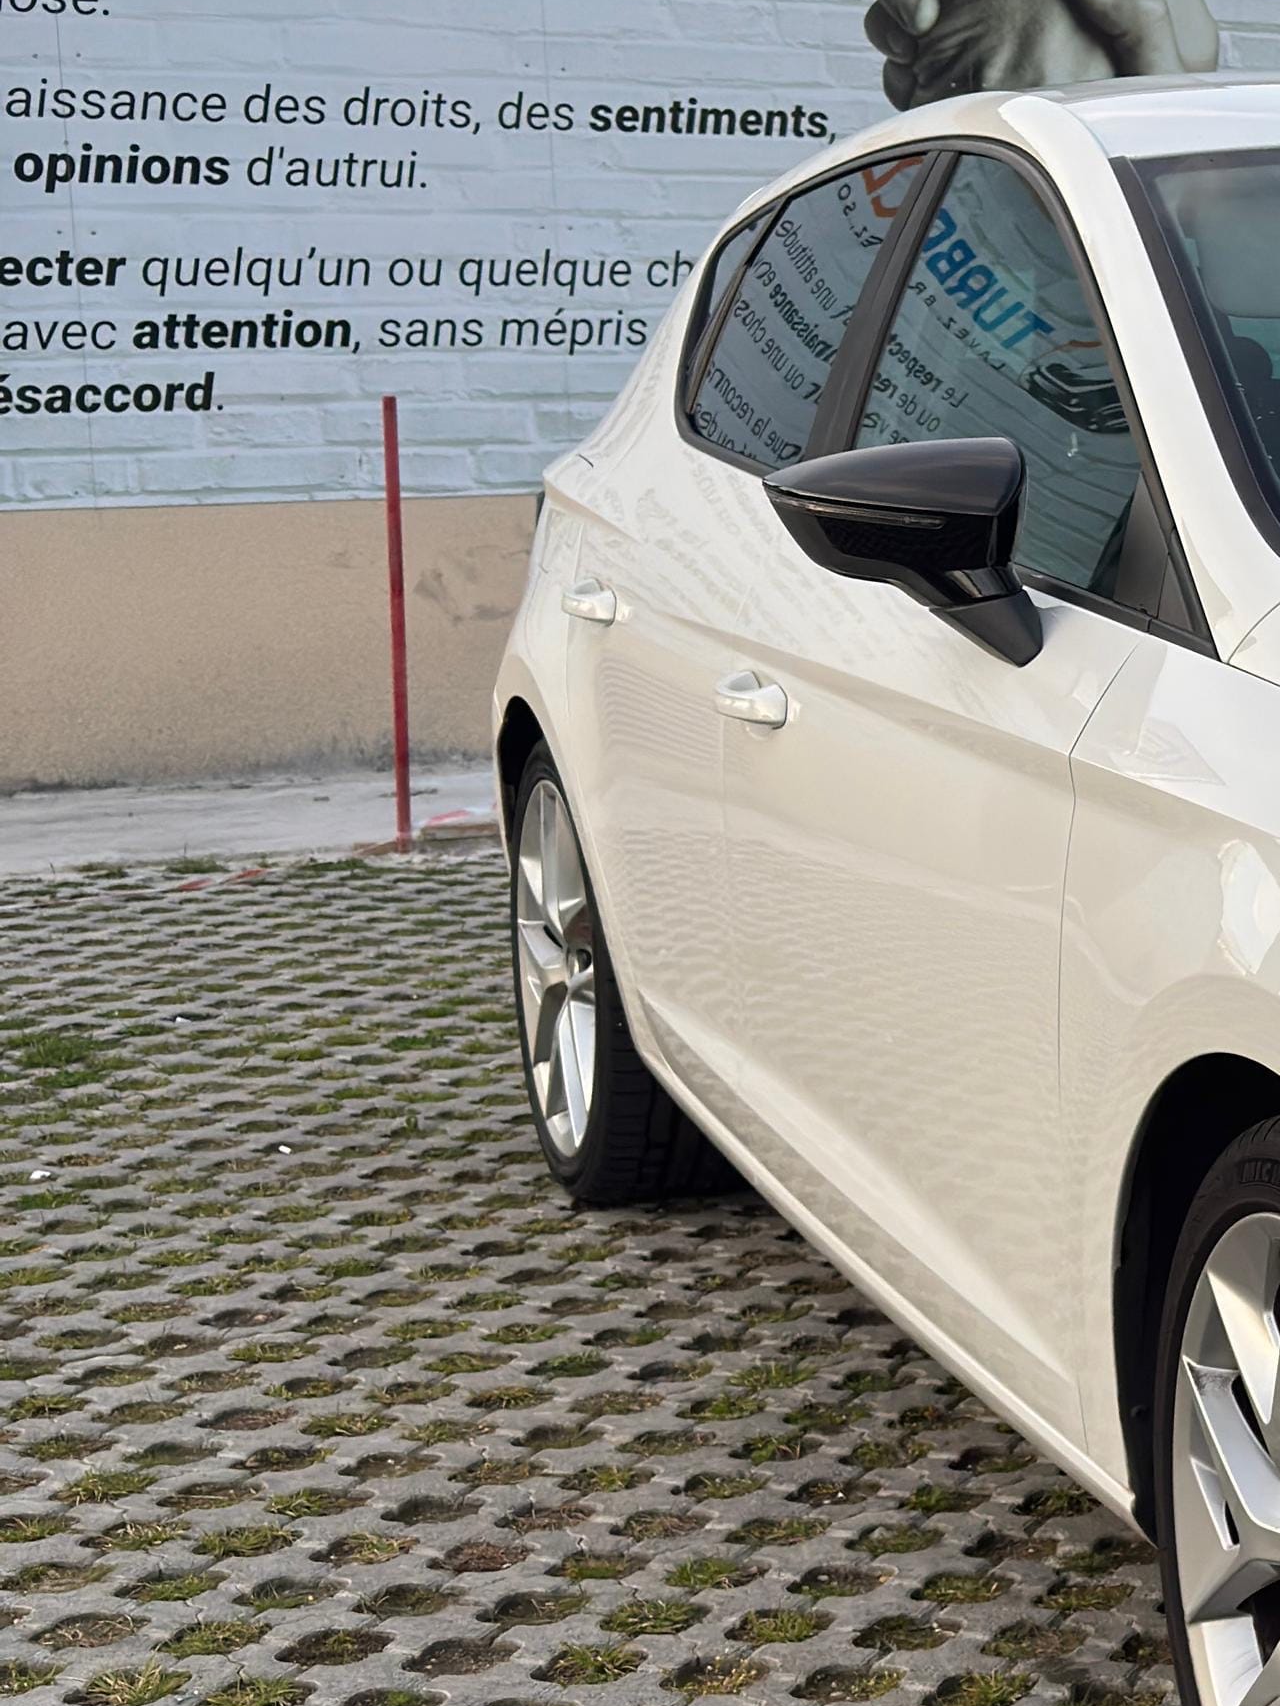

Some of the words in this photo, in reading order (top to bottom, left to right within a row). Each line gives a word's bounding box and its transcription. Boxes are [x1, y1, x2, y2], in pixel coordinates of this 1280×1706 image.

[244, 83, 327, 125] des
[344, 87, 481, 135] droits,
[498, 92, 575, 131] des
[589, 98, 837, 144] sentiments,
[14, 143, 230, 193] opinions
[247, 146, 427, 189] d'autrui.
[388, 257, 443, 287] ou
[459, 249, 632, 296] quelque
[3, 320, 117, 351] avec
[132, 309, 360, 355] attention,
[378, 317, 484, 349] sans
[499, 307, 648, 356] mépris
